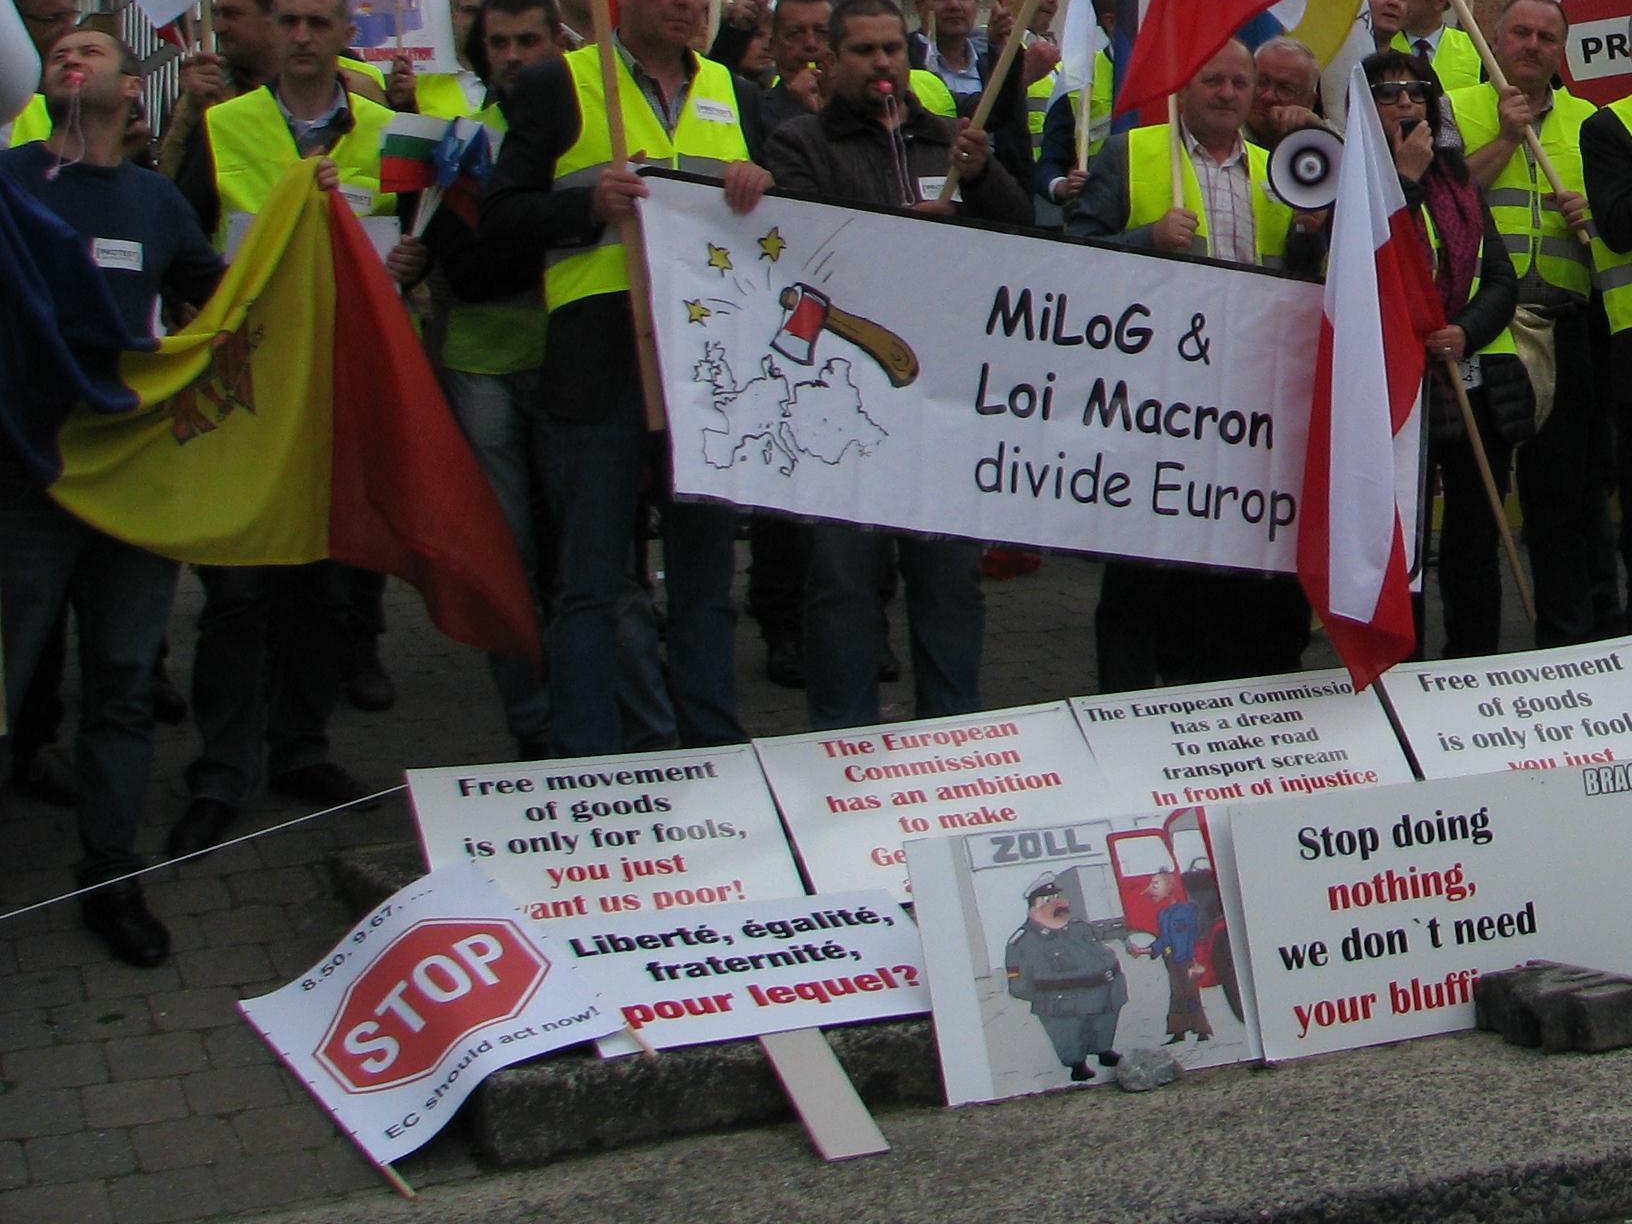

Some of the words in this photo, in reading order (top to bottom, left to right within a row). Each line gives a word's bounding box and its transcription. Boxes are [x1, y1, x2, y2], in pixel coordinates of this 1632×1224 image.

[986, 285, 1153, 355] MiLoG
[1177, 314, 1212, 364] &
[975, 361, 1056, 420] Loi
[1083, 377, 1275, 450] Macron
[974, 441, 1132, 509] divide
[1152, 460, 1297, 543] Europ
[1417, 669, 1480, 695] Free
[1486, 651, 1624, 687] movement
[1084, 706, 1129, 723] The
[1132, 695, 1235, 723] European
[1238, 680, 1353, 710] Commissio
[1169, 717, 1212, 735] has
[1216, 718, 1231, 731] a
[1234, 707, 1304, 731] dream
[1478, 695, 1507, 719] of
[1513, 688, 1593, 718] goods
[818, 734, 876, 760] The
[881, 719, 1021, 758] European
[1171, 740, 1203, 757] To
[1207, 733, 1265, 754] make
[1269, 726, 1320, 746] road
[1438, 731, 1467, 752] is
[1470, 724, 1530, 752] only
[1533, 717, 1577, 743] for
[458, 777, 535, 797] Free
[547, 761, 718, 792] movement
[843, 746, 1022, 785] Commission
[1162, 754, 1268, 781] transport
[1271, 746, 1348, 766] scream
[826, 789, 884, 814] has
[889, 786, 926, 810] an
[928, 768, 1062, 803] ambition
[1152, 790, 1179, 807] In
[1182, 781, 1243, 805] front
[1248, 777, 1273, 796] of
[1278, 767, 1378, 794] injustice
[526, 801, 560, 822] of
[571, 794, 672, 824] goods
[898, 813, 930, 834] to
[936, 804, 1018, 832] make
[465, 838, 496, 858] is
[507, 829, 580, 856] only
[590, 825, 641, 849] for
[653, 818, 748, 844] fools,
[990, 825, 1092, 863] ZOLL
[1297, 817, 1380, 863] Stop
[1391, 807, 1493, 851] doing
[547, 862, 610, 889] you
[621, 853, 687, 884] just
[1327, 863, 1477, 912] nothing,
[527, 894, 587, 921] ant
[599, 892, 641, 913] us
[653, 880, 745, 911] poor!
[569, 926, 735, 959] Liberté,
[741, 903, 896, 943] égalité,
[1279, 939, 1329, 972] we
[1453, 902, 1538, 946] need
[645, 937, 862, 982] fraternité,
[343, 933, 505, 1075] STOP
[620, 988, 735, 1030] pour
[746, 963, 921, 1009] lequel?
[1294, 989, 1382, 1038] your
[385, 1110, 421, 1140] EC
[425, 1040, 493, 1110] should
[498, 1025, 539, 1046] act
[542, 1006, 601, 1033] now!
